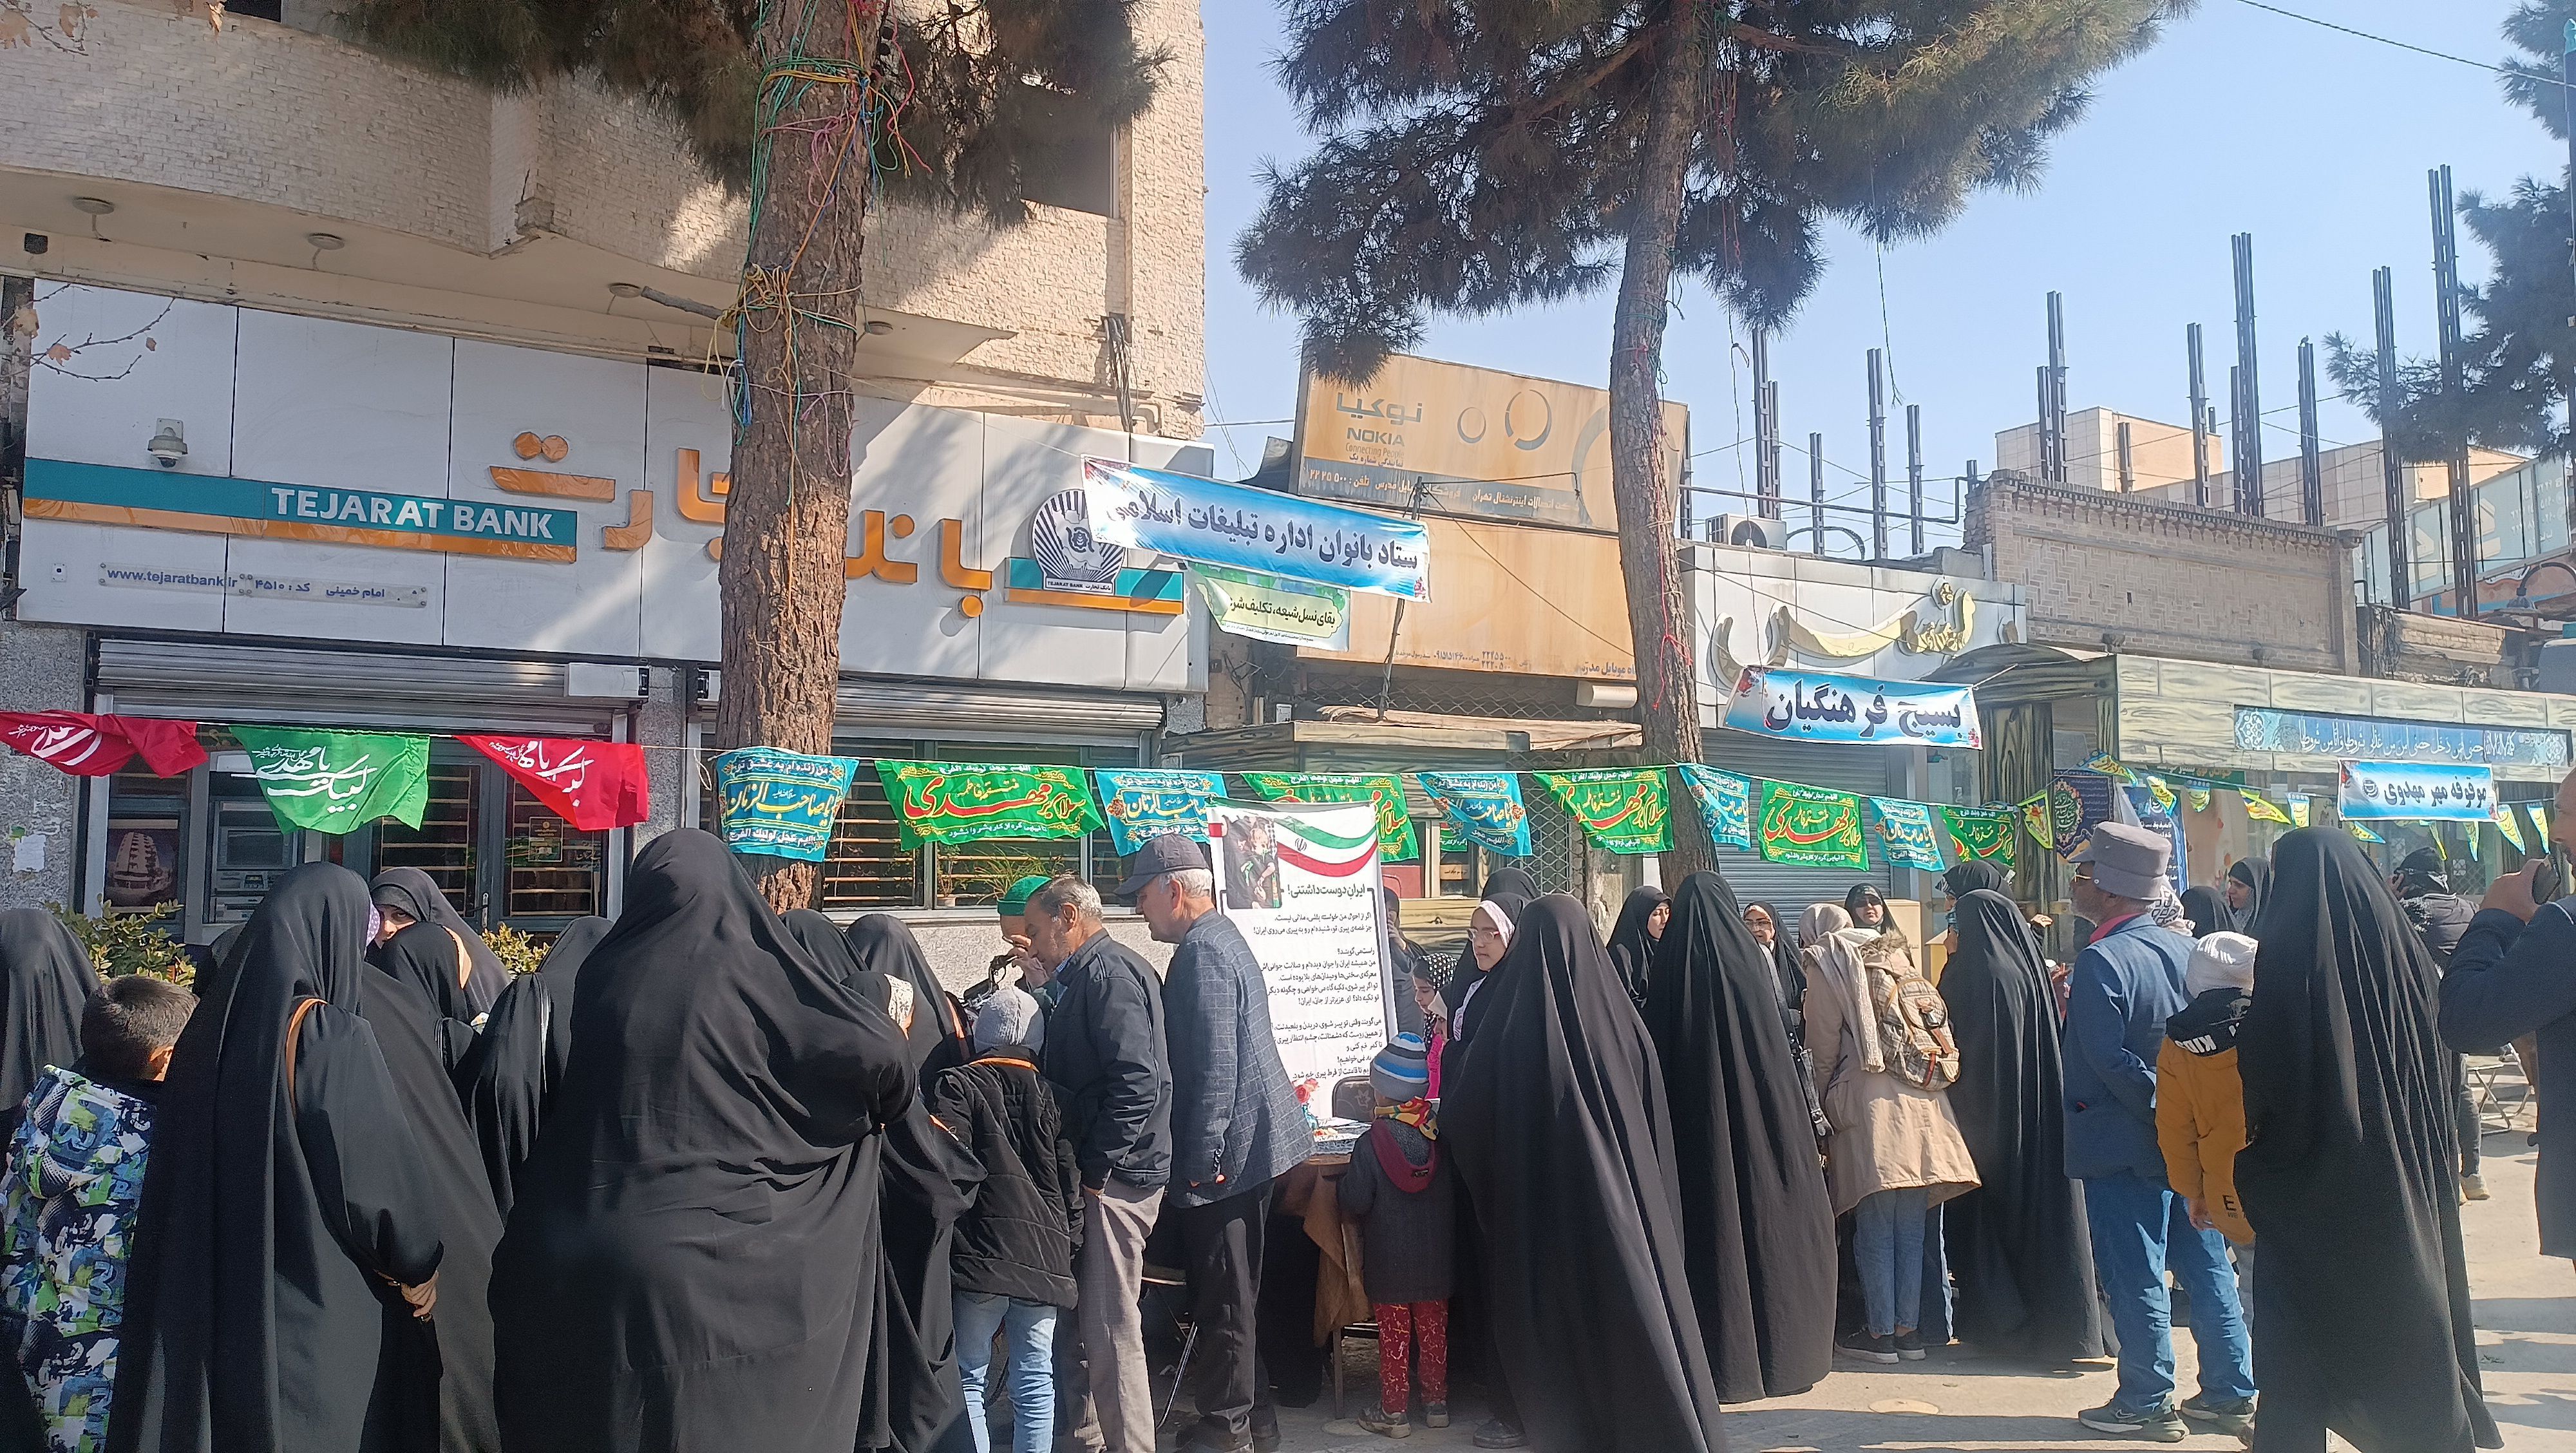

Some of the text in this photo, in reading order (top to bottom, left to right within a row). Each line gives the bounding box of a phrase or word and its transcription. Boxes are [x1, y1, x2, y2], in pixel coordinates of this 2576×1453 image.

[1336, 392, 1423, 426] نوکیا
[1347, 427, 1405, 447] NOKIA
[1345, 442, 1405, 460] Connecting People
[1349, 453, 1403, 468] نمایندگی شماره یک
[1375, 480, 1397, 491] مدرس
[1472, 489, 1492, 502] تهران
[270, 487, 554, 540] TEJARAT BANK
[1188, 504, 1258, 547] تبلیغات
[1265, 523, 1313, 555] اداره
[1320, 531, 1372, 569] بانوان
[1378, 540, 1418, 569] ستاد
[107, 567, 238, 588] www.tejaratbank.ir
[326, 585, 361, 597] خمینی
[362, 588, 386, 598] امام
[1245, 598, 1273, 615] تکلیف
[1298, 609, 1317, 623] نسل
[1316, 612, 1336, 629] بقای
[1766, 680, 1963, 739] بسیج فرهنگیان
[734, 761, 746, 773] تو
[748, 758, 773, 770] عشق
[775, 761, 785, 772] به
[796, 762, 816, 774] زنده
[817, 765, 828, 776] من
[726, 781, 770, 817] الزمان
[903, 776, 1052, 819] مهدی
[2384, 776, 2486, 808] موقوفه مهر مهدوی
[1052, 792, 1086, 819] سلام
[1379, 800, 1408, 839] سلام
[1763, 799, 1850, 844] مهدی
[1340, 959, 1350, 968] ایران
